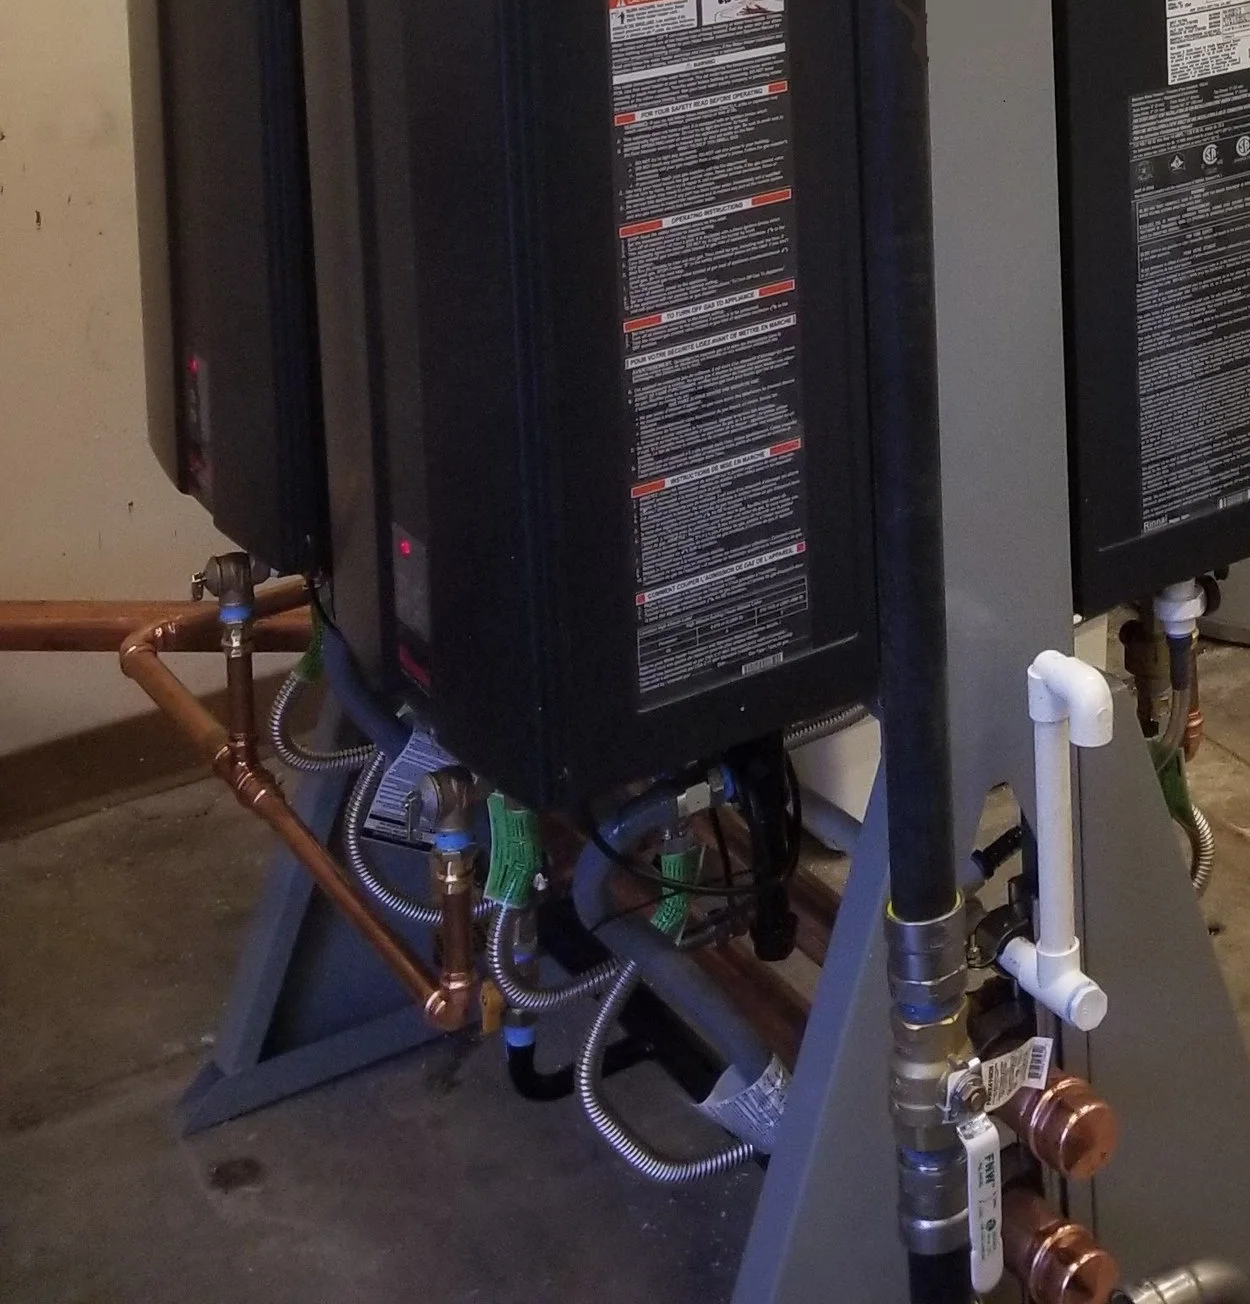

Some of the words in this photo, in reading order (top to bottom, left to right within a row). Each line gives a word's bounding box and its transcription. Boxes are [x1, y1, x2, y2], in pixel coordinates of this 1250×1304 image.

[641, 110, 653, 118] FOR
[655, 107, 669, 115] YOUR
[671, 102, 691, 112] SAFETY
[693, 99, 708, 107] READ
[709, 94, 731, 104] BEFORE
[732, 88, 762, 99] OPERATING
[671, 210, 702, 223] OPERATING
[704, 201, 742, 216] INSTRUCTIONS
[670, 467, 710, 484] INSTRUCTIONS
[984, 1153, 995, 1187] FNW
